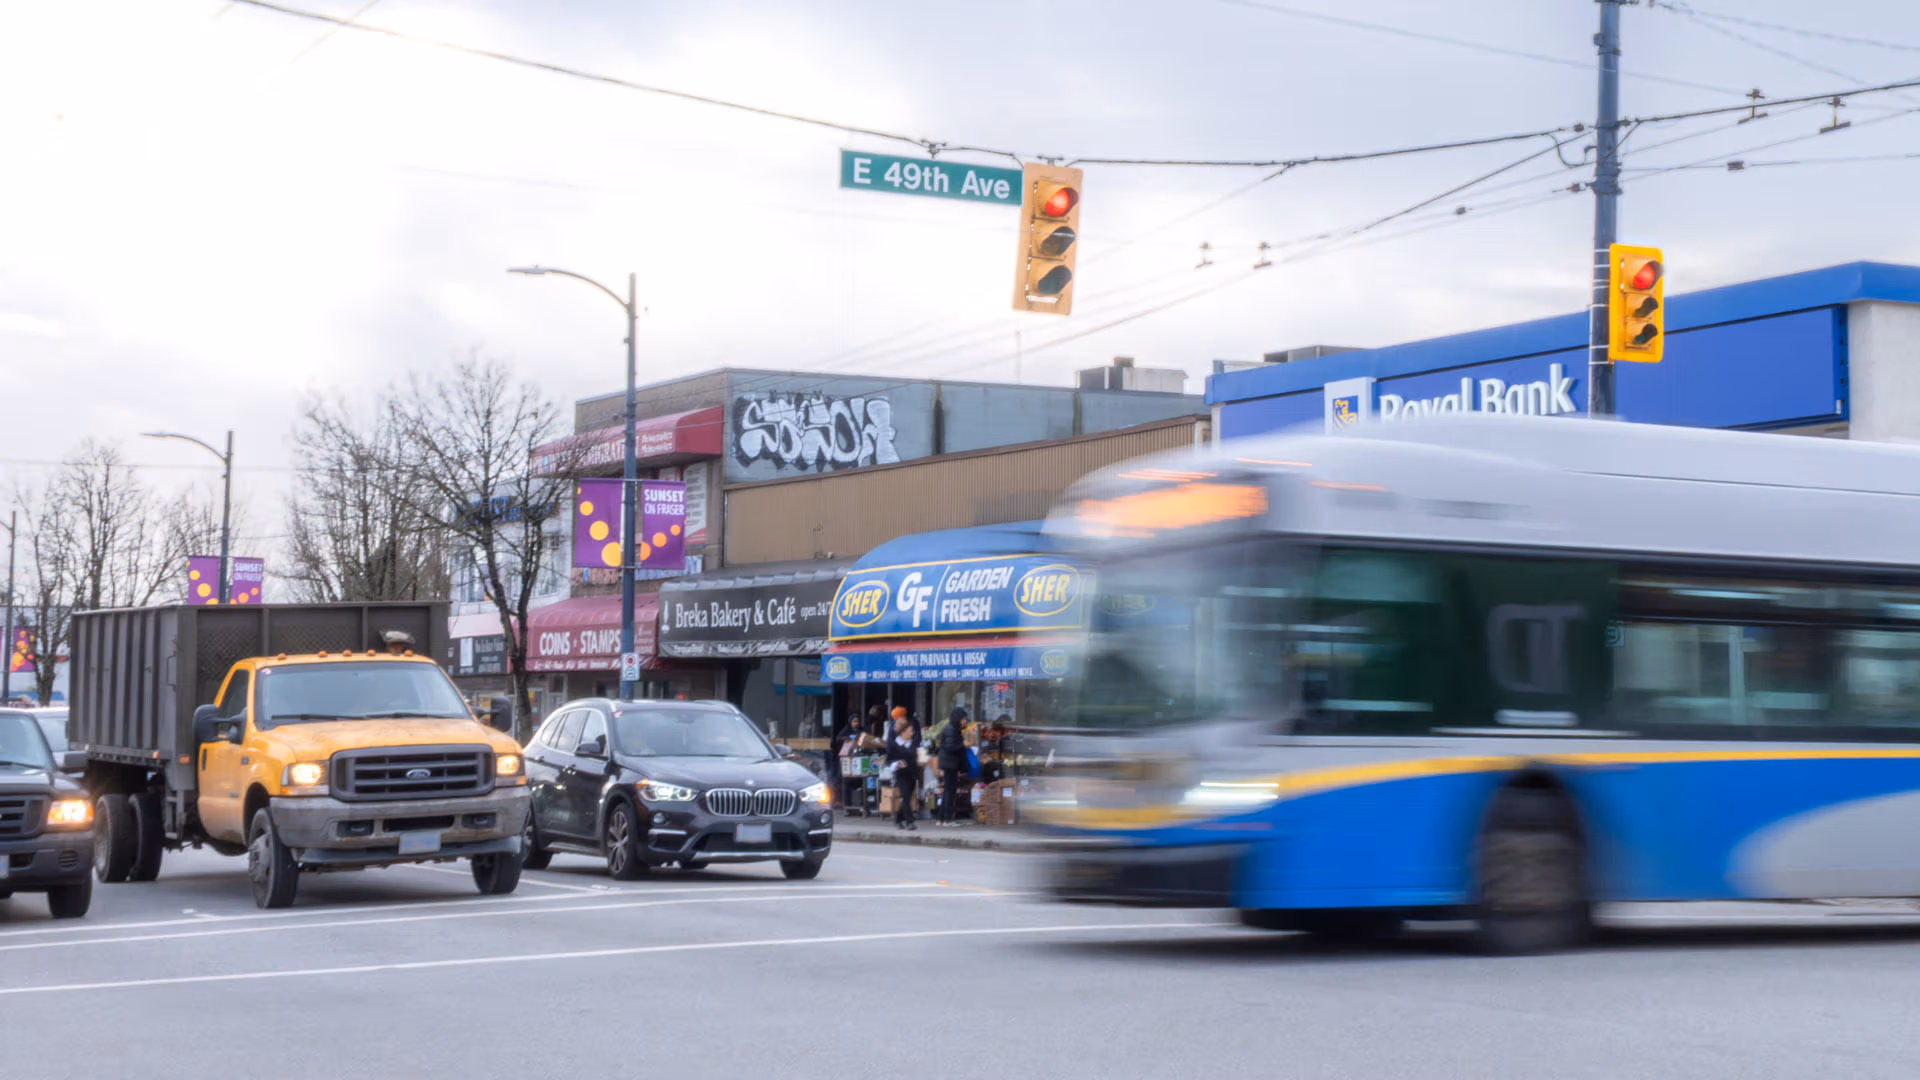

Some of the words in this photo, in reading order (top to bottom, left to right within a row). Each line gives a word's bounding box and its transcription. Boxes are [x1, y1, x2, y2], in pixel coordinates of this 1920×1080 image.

[854, 157, 871, 184] E
[884, 161, 949, 193] 49th
[961, 170, 1010, 199] Ave
[1480, 363, 1576, 415] Bank
[644, 488, 685, 502] SUNSET
[644, 503, 656, 515] ON
[657, 503, 685, 515] FRASER
[945, 566, 1014, 594] GARDEN
[1021, 574, 1071, 605] SHER
[842, 588, 883, 617] SHER
[896, 572, 933, 628] GF
[941, 597, 992, 623] FRESH
[675, 602, 708, 628] Breka
[711, 601, 751, 633] Bakery
[754, 600, 764, 626] &
[767, 597, 796, 626] Café
[801, 606, 816, 621] open
[540, 631, 571, 656] COINS
[580, 629, 621, 654] STAMPS
